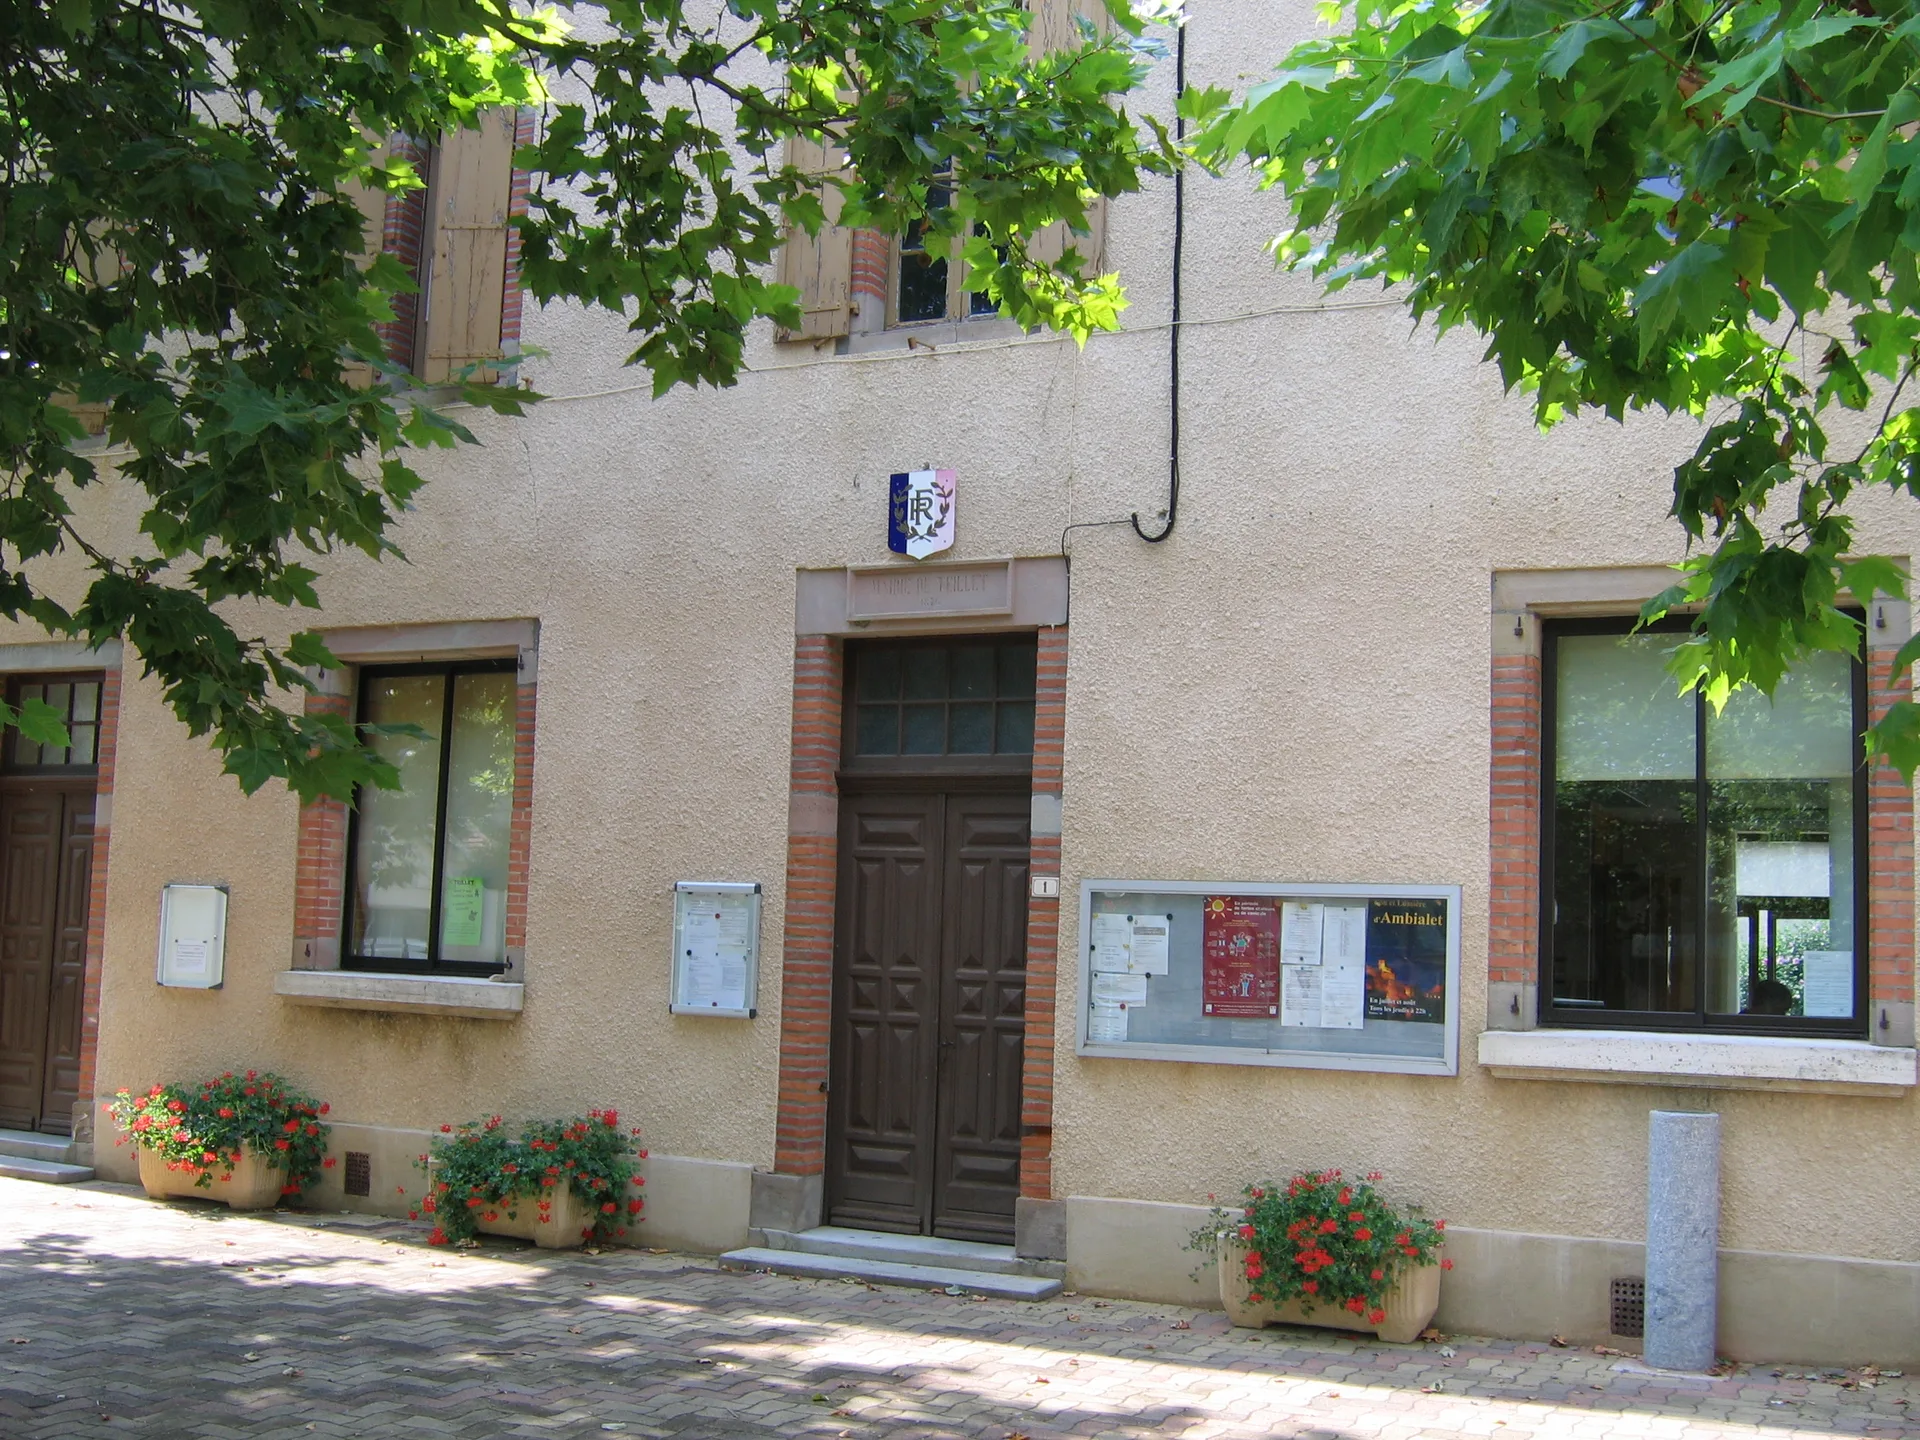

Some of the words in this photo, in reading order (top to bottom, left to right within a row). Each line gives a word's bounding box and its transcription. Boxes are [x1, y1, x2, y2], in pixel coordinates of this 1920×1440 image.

[871, 578, 911, 595] MAIRIE
[916, 576, 930, 593] DE
[937, 573, 989, 593] TEILLET
[1043, 881, 1047, 893] 1
[1373, 911, 1444, 926] d'Ambialet
